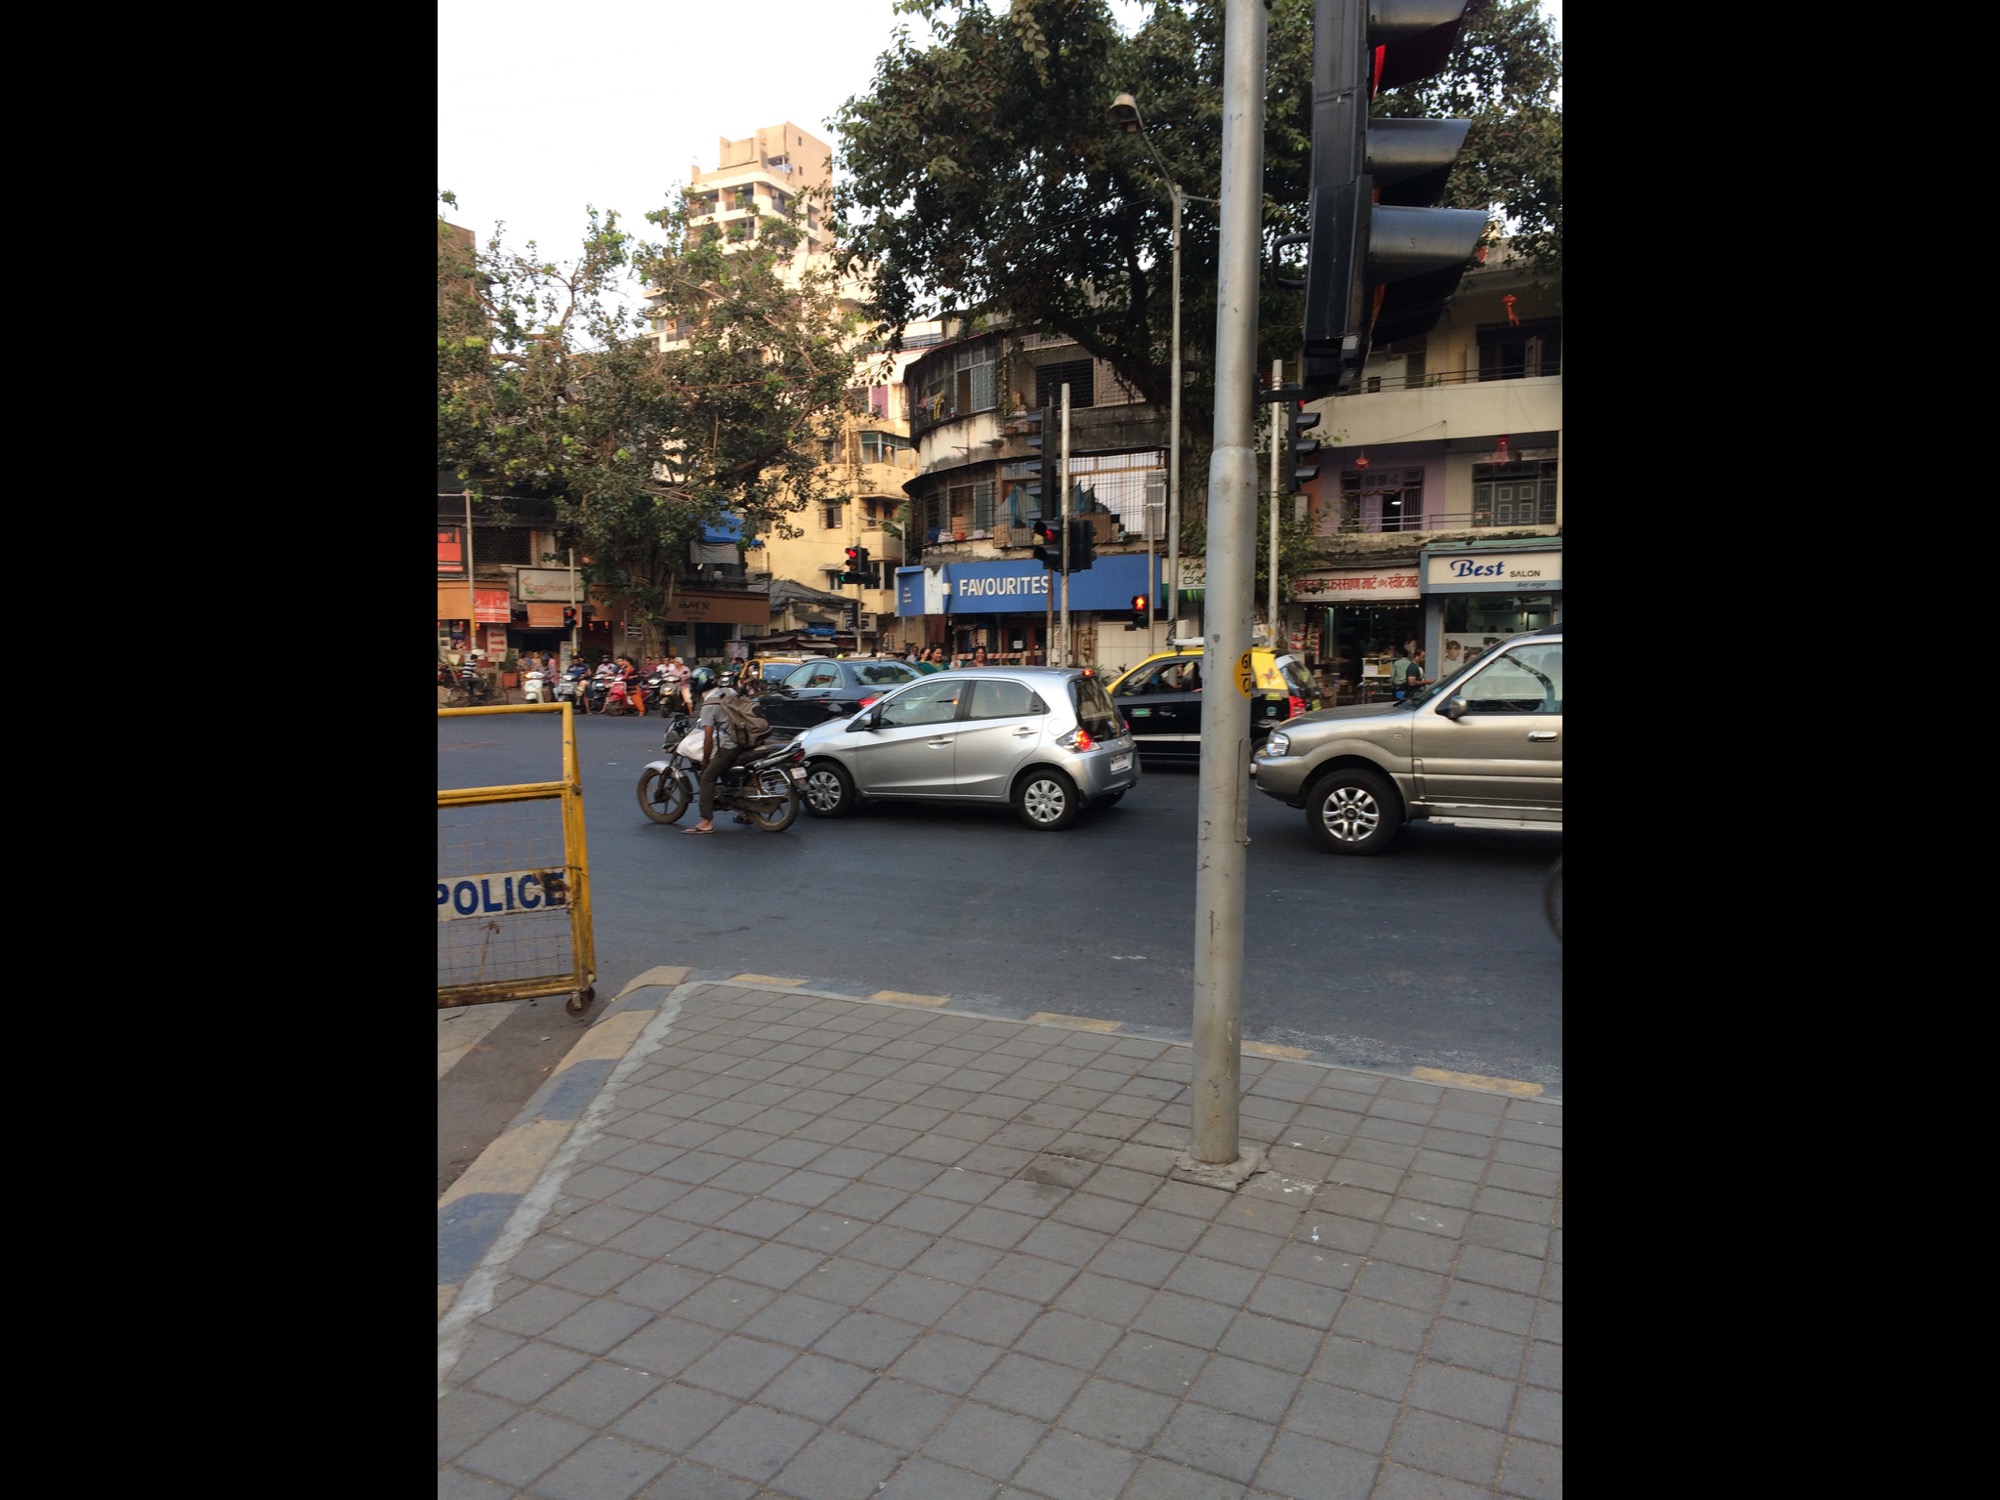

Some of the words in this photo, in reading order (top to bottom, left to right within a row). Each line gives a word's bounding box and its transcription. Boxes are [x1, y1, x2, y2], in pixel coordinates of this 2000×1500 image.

[1450, 559, 1505, 578] Best
[1510, 570, 1541, 578] SALON
[959, 575, 1050, 597] FAVOURITES
